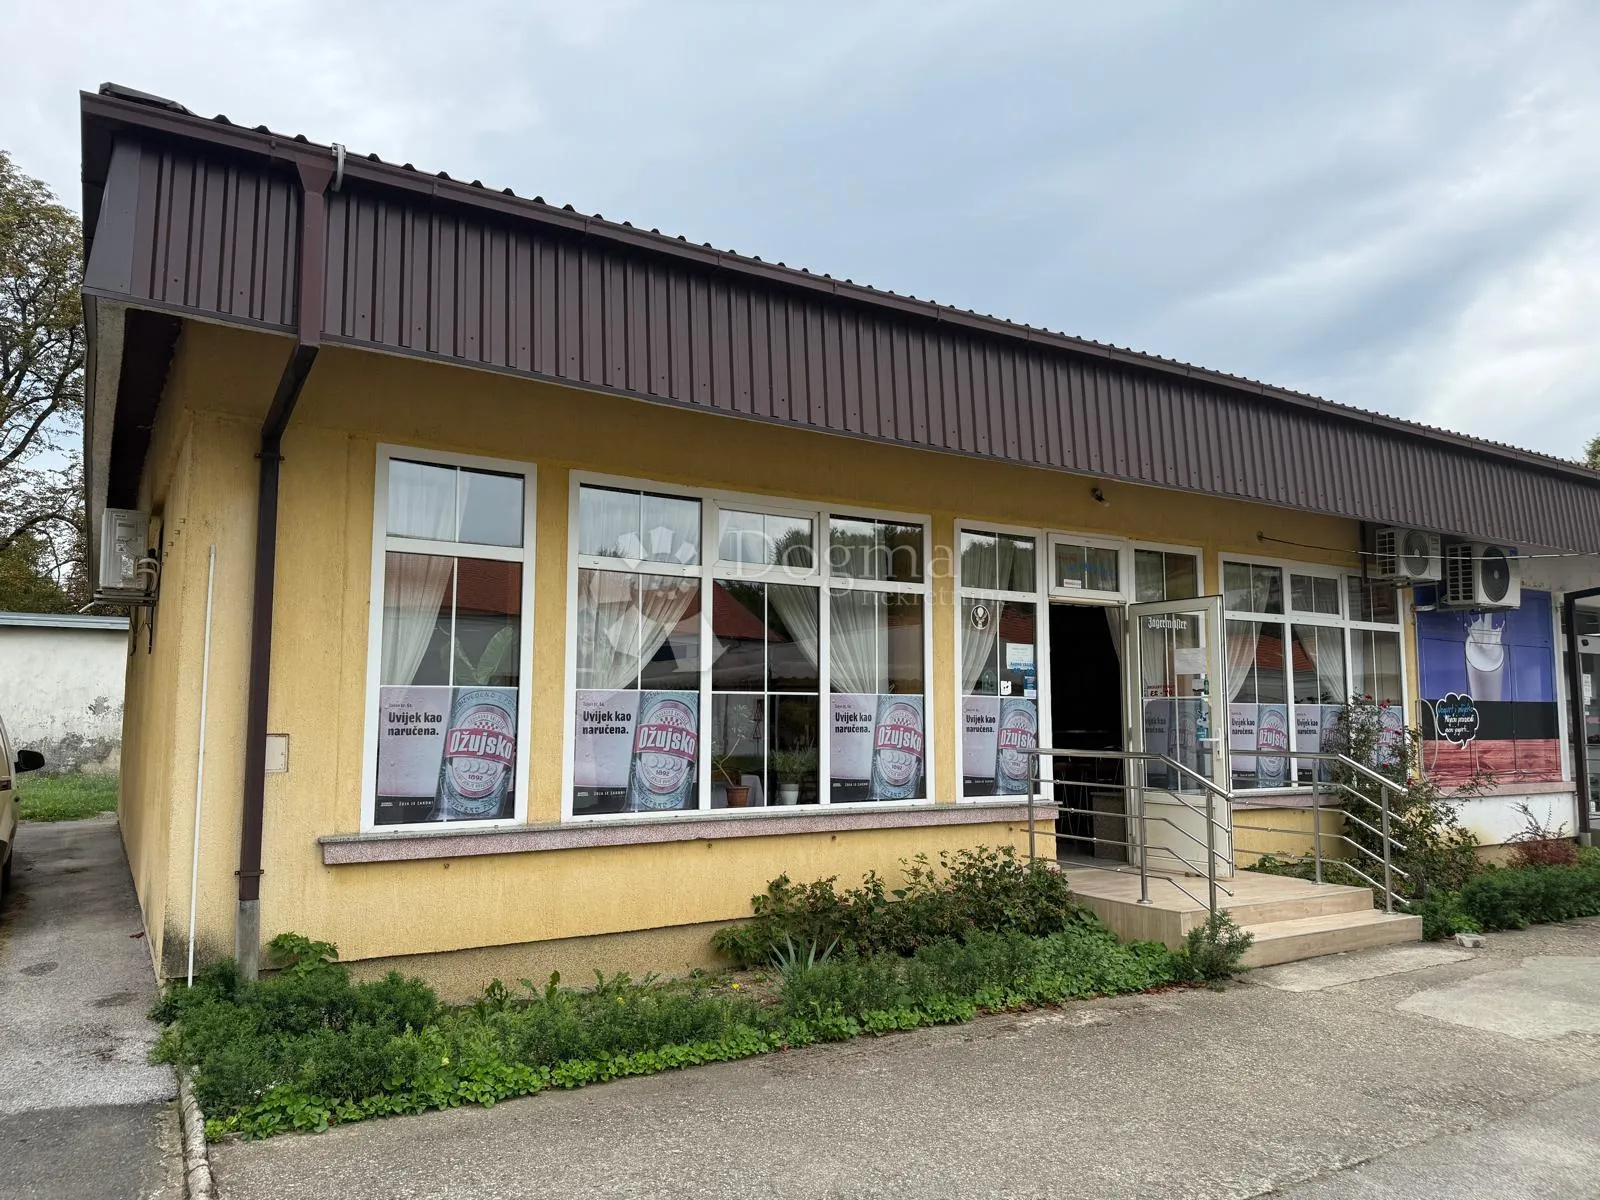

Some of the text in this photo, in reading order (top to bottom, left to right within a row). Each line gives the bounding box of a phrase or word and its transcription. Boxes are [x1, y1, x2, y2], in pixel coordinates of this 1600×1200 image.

[388, 711, 443, 725] Uvijek kao
[583, 710, 632, 724] Uvijek kao
[835, 712, 872, 724] Uvijek kao
[966, 714, 996, 725] Uvijek kao
[1231, 717, 1255, 728] Uvijek kao
[835, 724, 871, 733] naručena.
[1296, 718, 1319, 728] Uvijek kao
[387, 726, 440, 736] naručena.
[582, 725, 629, 735] naručena.
[966, 725, 994, 733] naručena.
[449, 730, 513, 759] Ožujsko
[638, 727, 696, 755] Ožujsko
